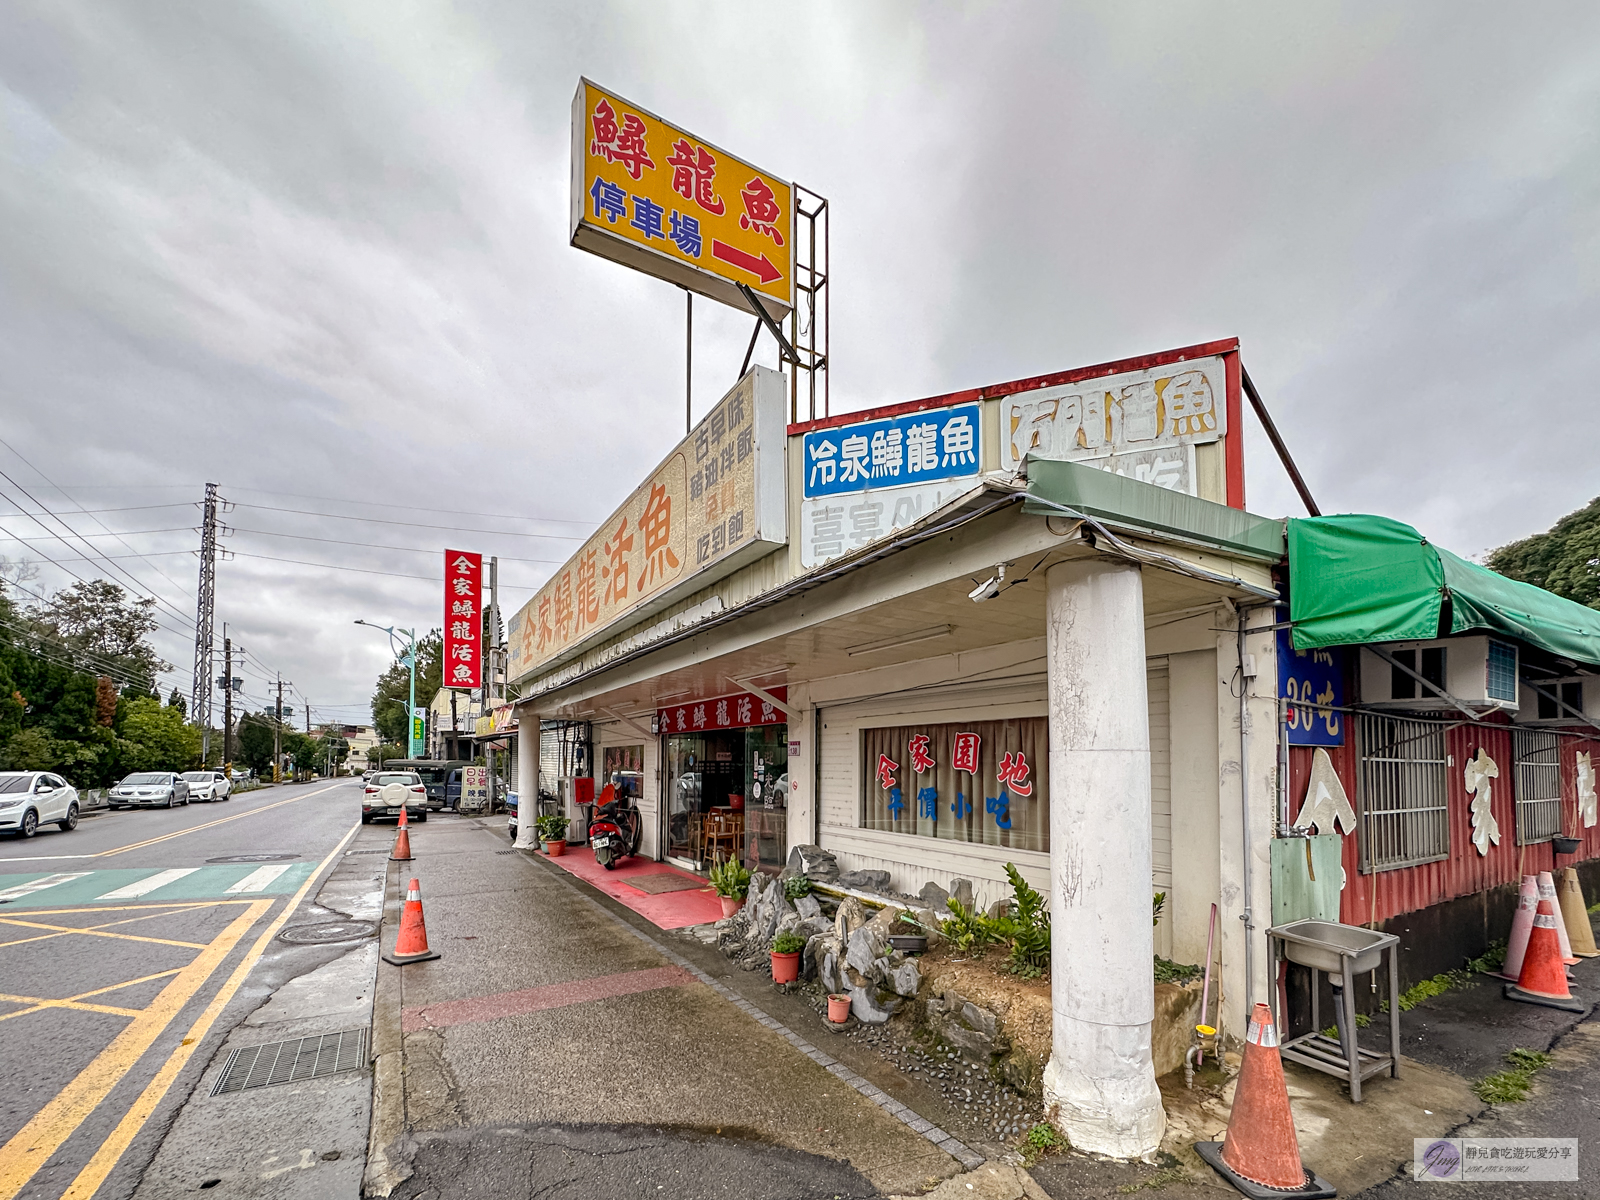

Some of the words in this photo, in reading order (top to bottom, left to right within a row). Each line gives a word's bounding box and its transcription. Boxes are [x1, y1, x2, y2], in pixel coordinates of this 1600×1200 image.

[589, 175, 703, 259] 停車場
[695, 390, 744, 464] 古早味
[696, 510, 744, 565] 吃到飽
[875, 732, 1033, 797] 全家園地
[887, 786, 1012, 830] 平價小吃
